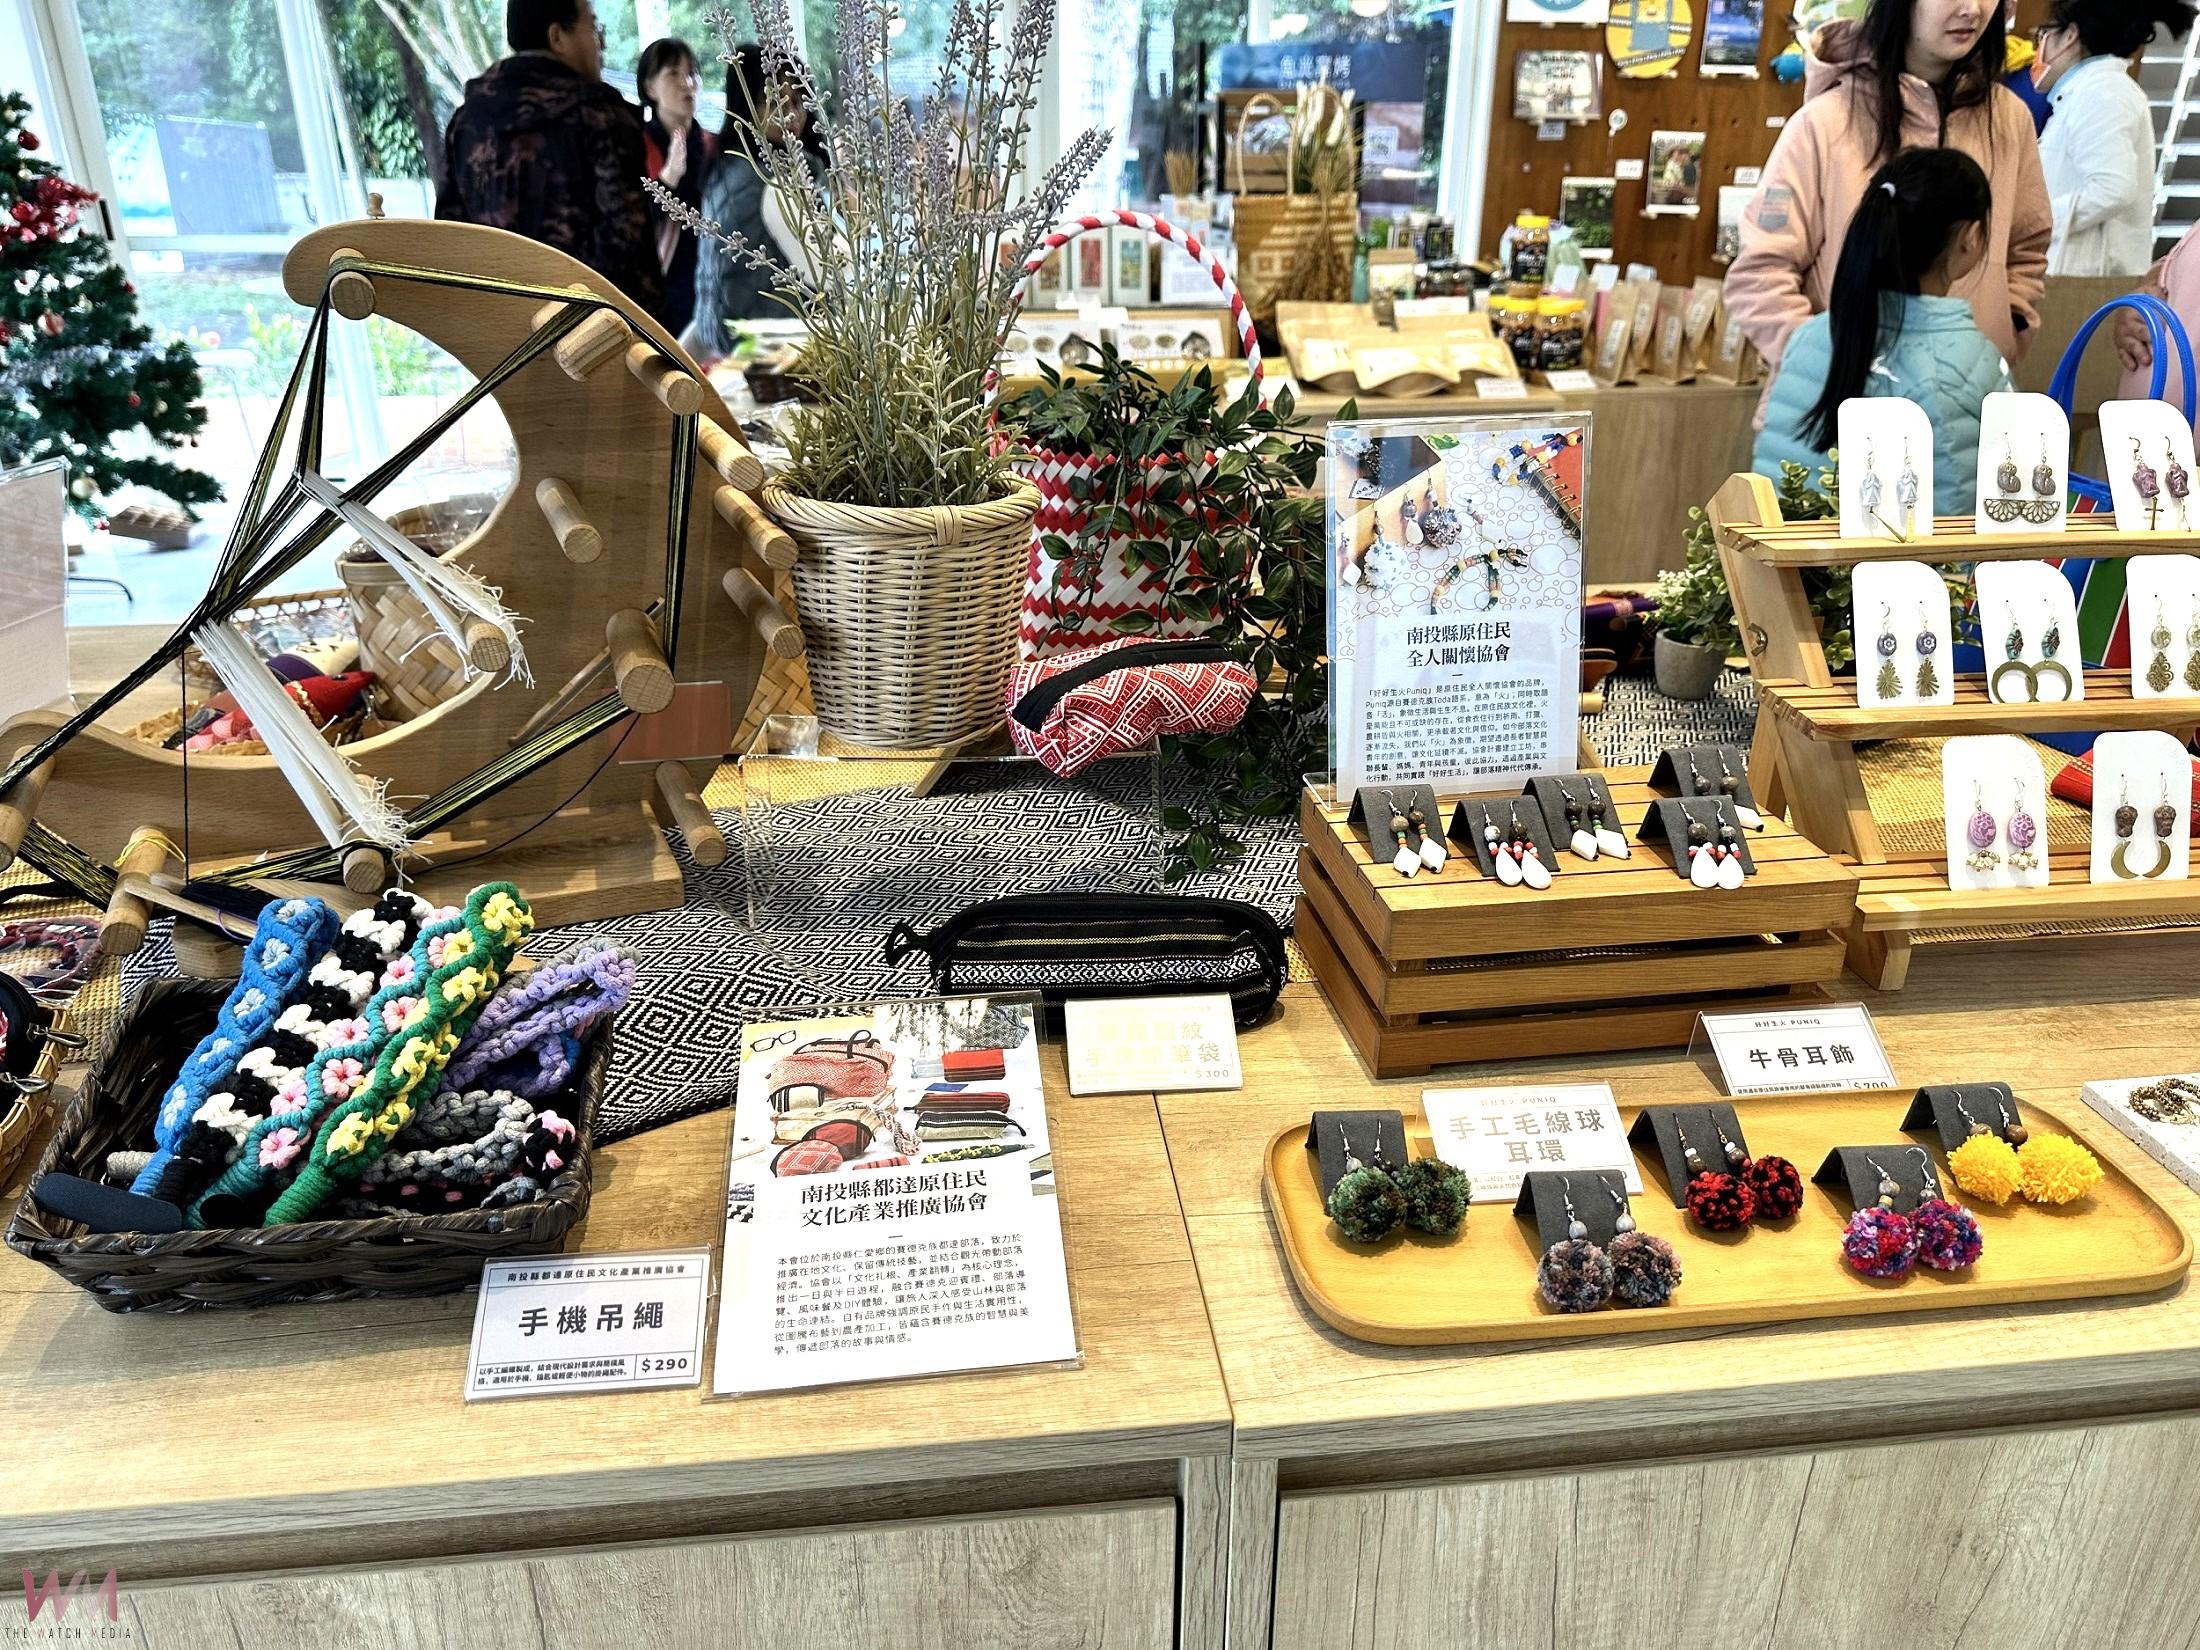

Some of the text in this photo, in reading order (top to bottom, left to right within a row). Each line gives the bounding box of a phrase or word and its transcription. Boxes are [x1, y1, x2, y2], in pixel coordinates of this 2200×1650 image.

[1407, 622, 1511, 646] 南投縣原住民
[1407, 643, 1511, 667] 全人關懷協會
[1791, 1018, 1821, 1026] PUNIQ
[1749, 1044, 1855, 1070] 牛骨耳飾
[1195, 1069, 1230, 1079] $300
[1522, 1096, 1557, 1104] PUNIQ
[1450, 1108, 1604, 1139] 手工毛線球
[1504, 1139, 1566, 1164] 耳環
[801, 1169, 988, 1205] 南投縣都達原住民
[801, 1192, 988, 1228] 文化產業推廣協會
[508, 1265, 686, 1282] 南投縣都達原住民文化產業推廣協會
[518, 1301, 664, 1336] 手機吊繩
[641, 1358, 688, 1374] $290
